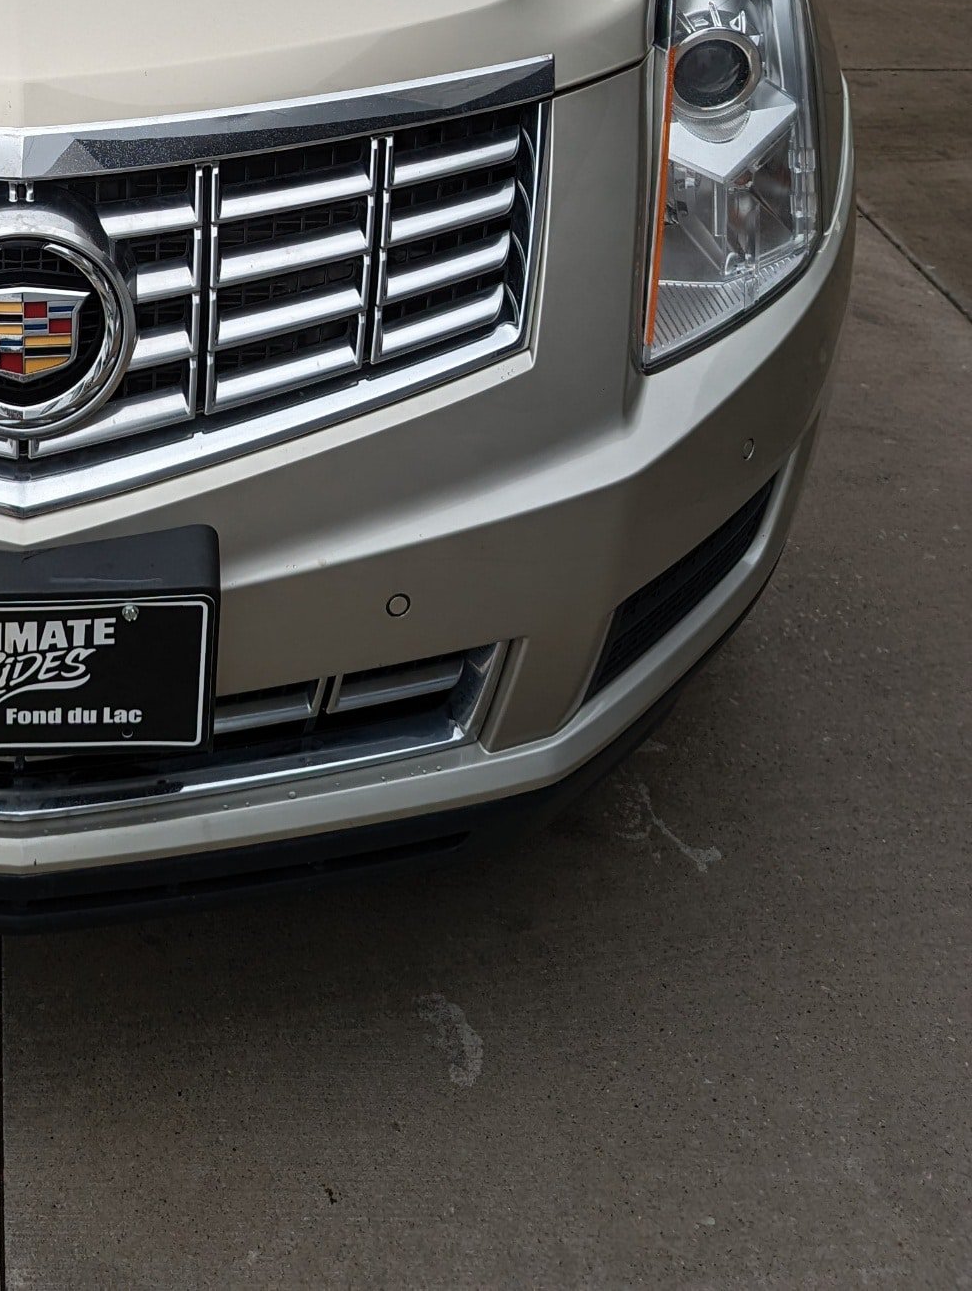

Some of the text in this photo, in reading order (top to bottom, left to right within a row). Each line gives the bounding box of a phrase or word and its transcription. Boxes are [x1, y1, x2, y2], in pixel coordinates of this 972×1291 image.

[5, 707, 62, 725] Fond
[67, 708, 97, 725] du
[103, 706, 143, 725] Lac
